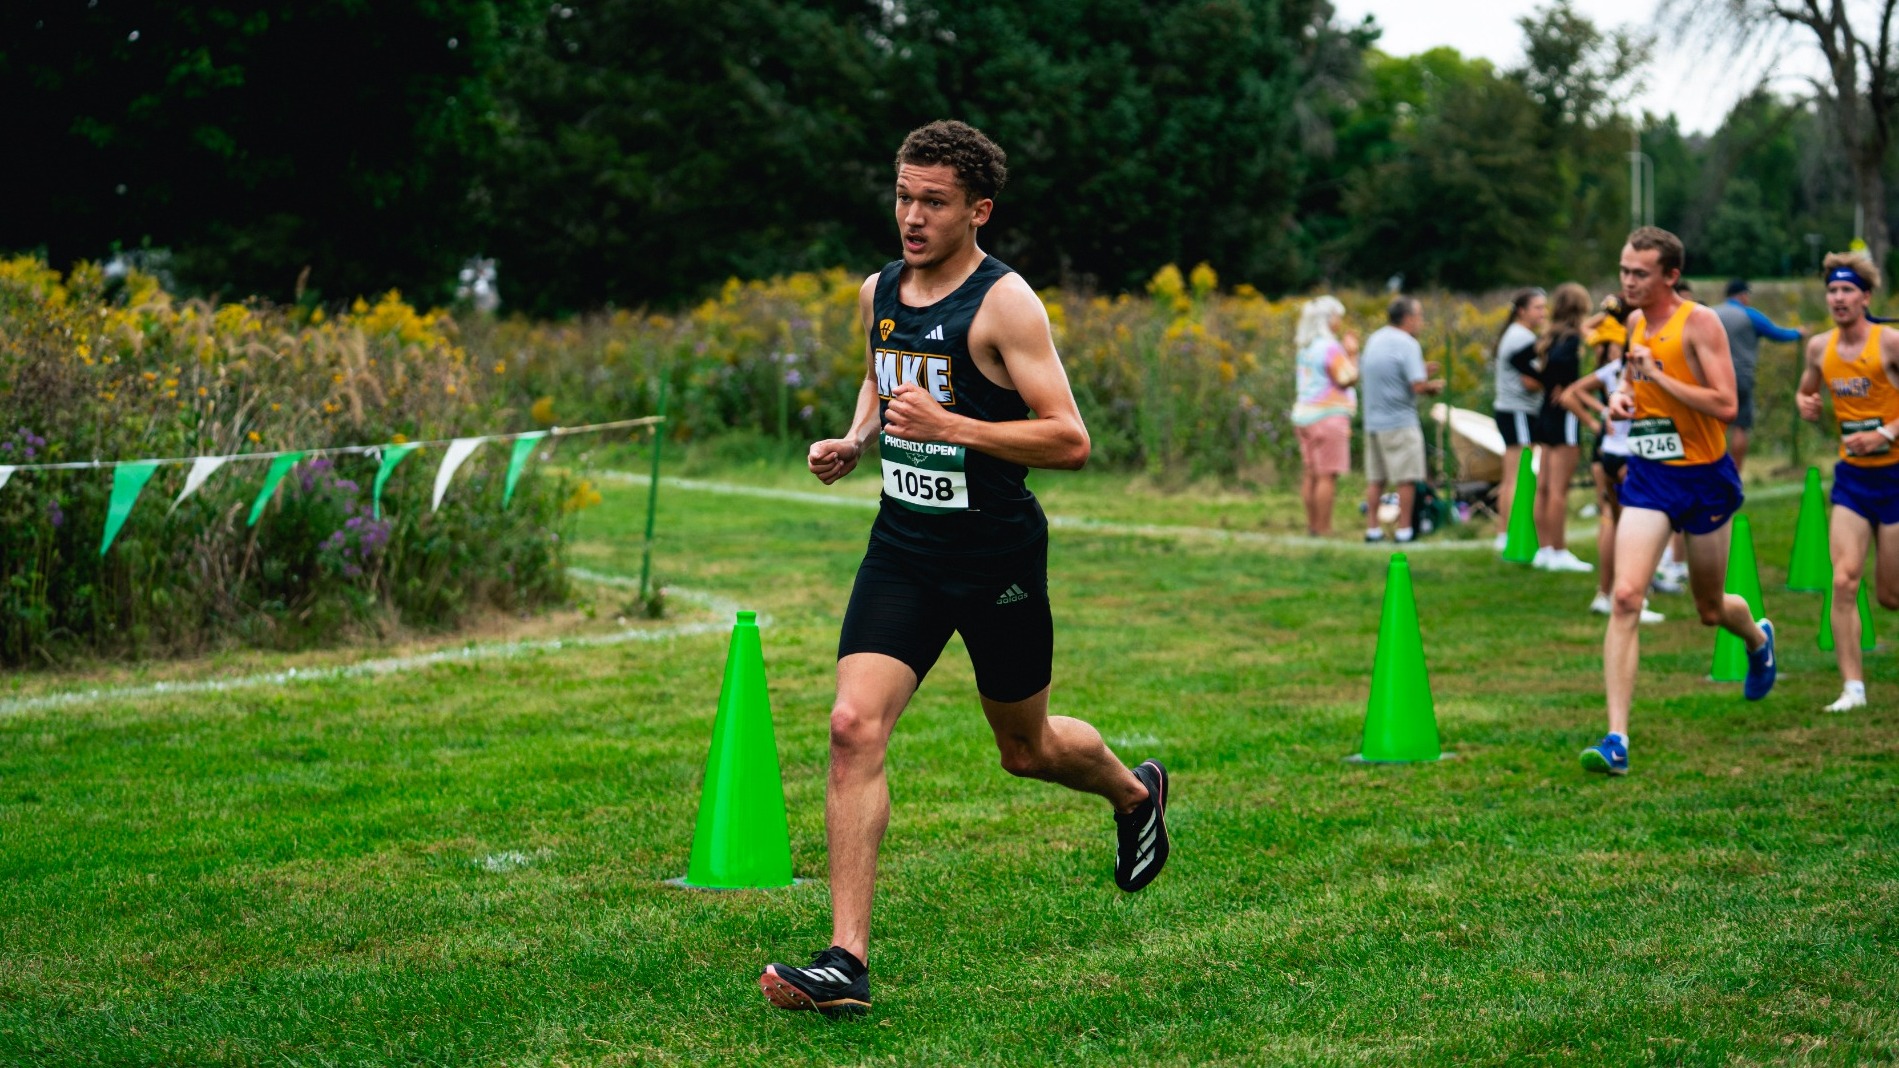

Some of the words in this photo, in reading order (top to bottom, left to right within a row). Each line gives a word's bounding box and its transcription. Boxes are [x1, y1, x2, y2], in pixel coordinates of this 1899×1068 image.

[875, 348, 956, 406] MKE
[884, 434, 924, 454] PHOENIX
[925, 443, 957, 456] OPEN
[1636, 437, 1677, 457] 1246
[892, 468, 954, 501] 1058
[996, 592, 1028, 605] adidas
